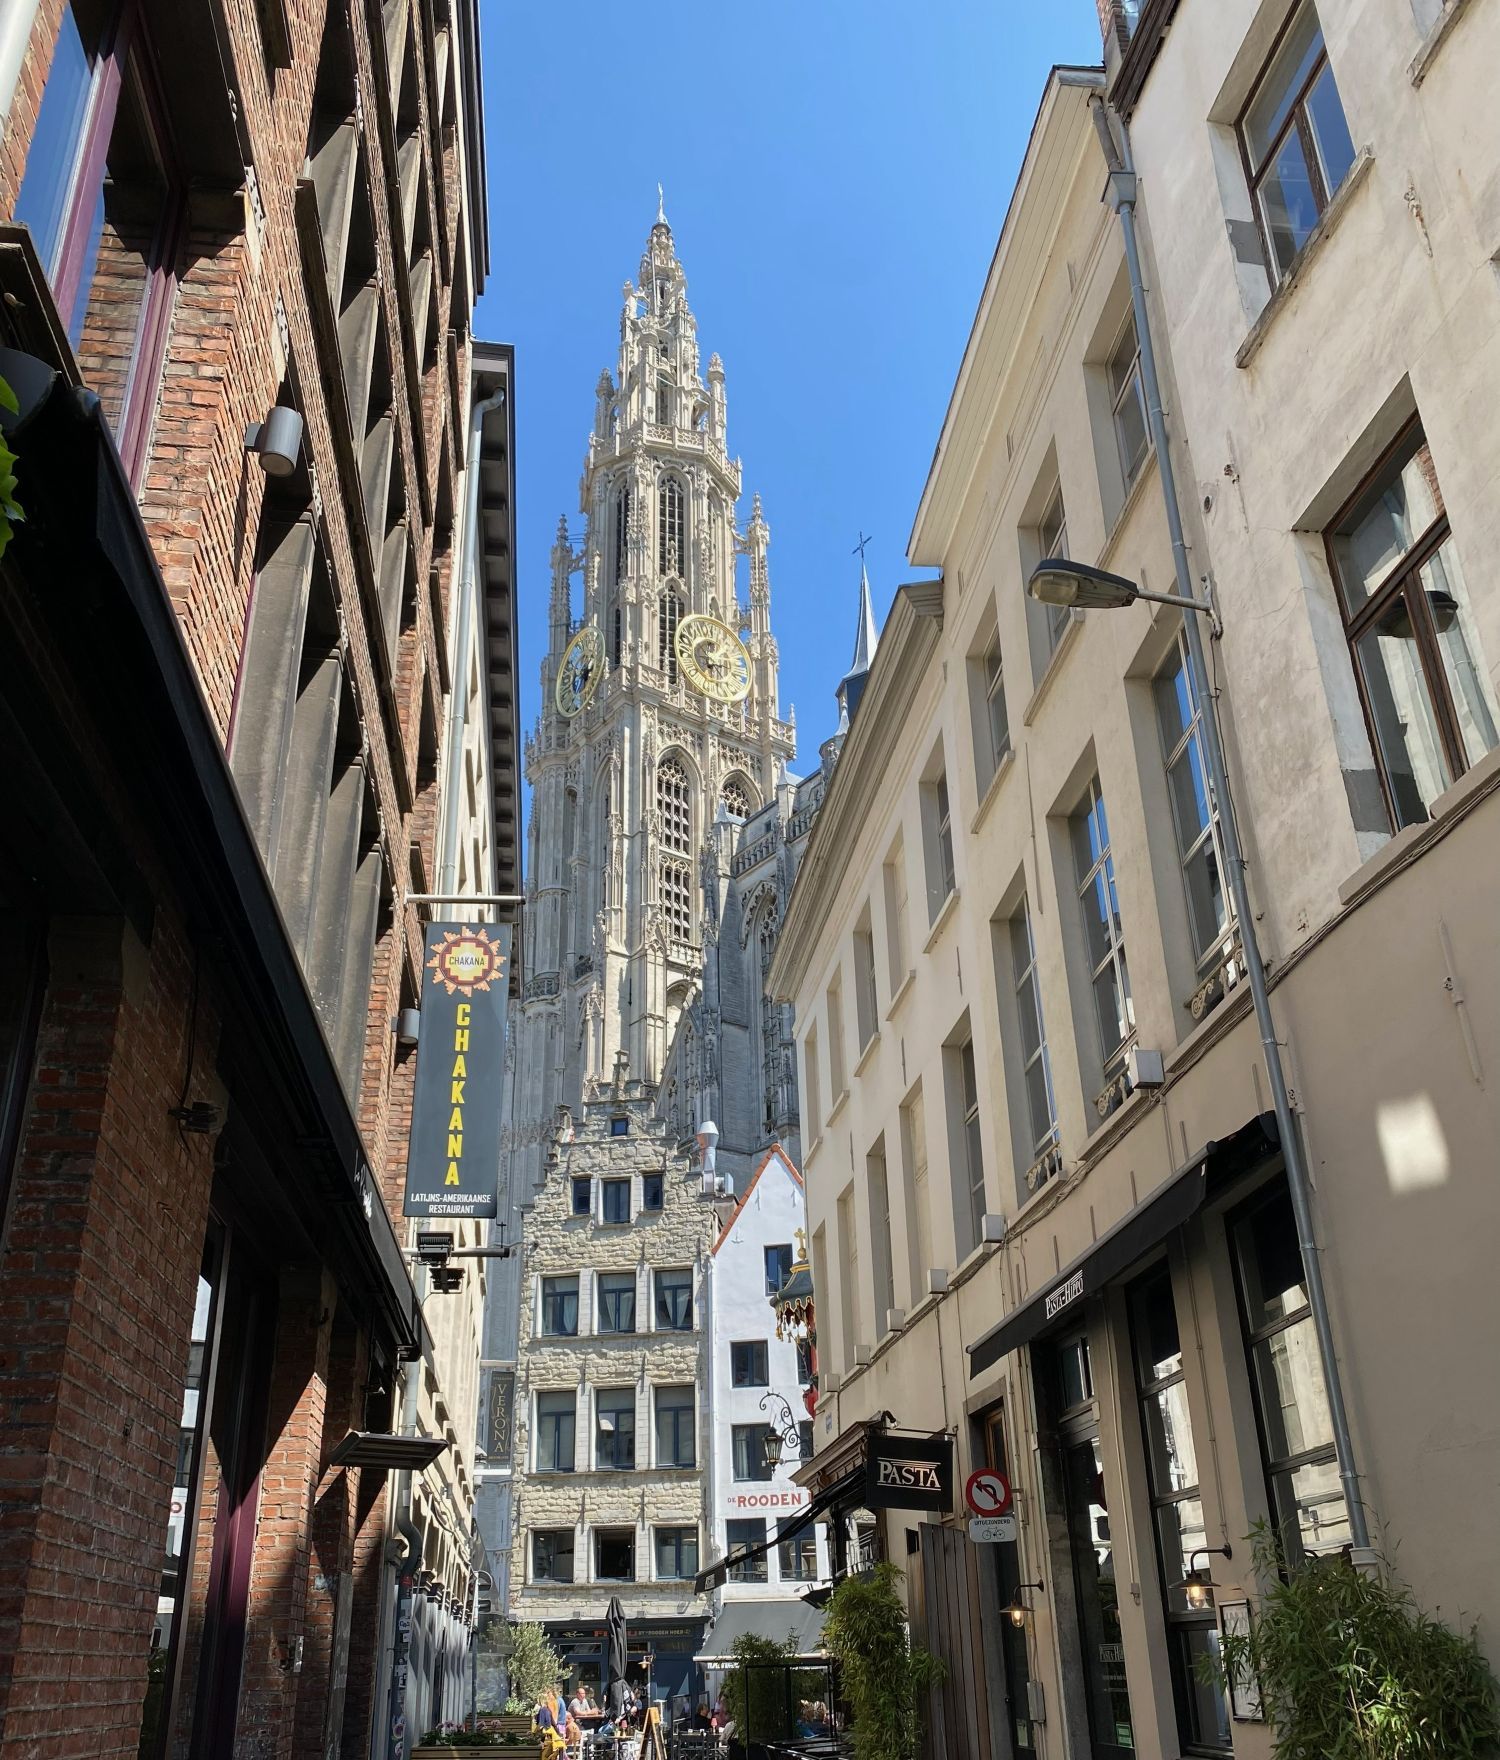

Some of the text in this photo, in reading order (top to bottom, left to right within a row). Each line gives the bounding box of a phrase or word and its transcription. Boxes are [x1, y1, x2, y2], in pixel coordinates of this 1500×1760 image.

[449, 956, 485, 966] CHAKANA
[444, 1003, 471, 1186] CHAKANA
[411, 1193, 492, 1203] LATIJNS-AMERIKAANSE
[428, 1204, 475, 1214] RESTAURANT
[494, 1383, 507, 1453] VERONA
[877, 1459, 942, 1488] PASTA
[737, 1493, 802, 1508] ROODEN
